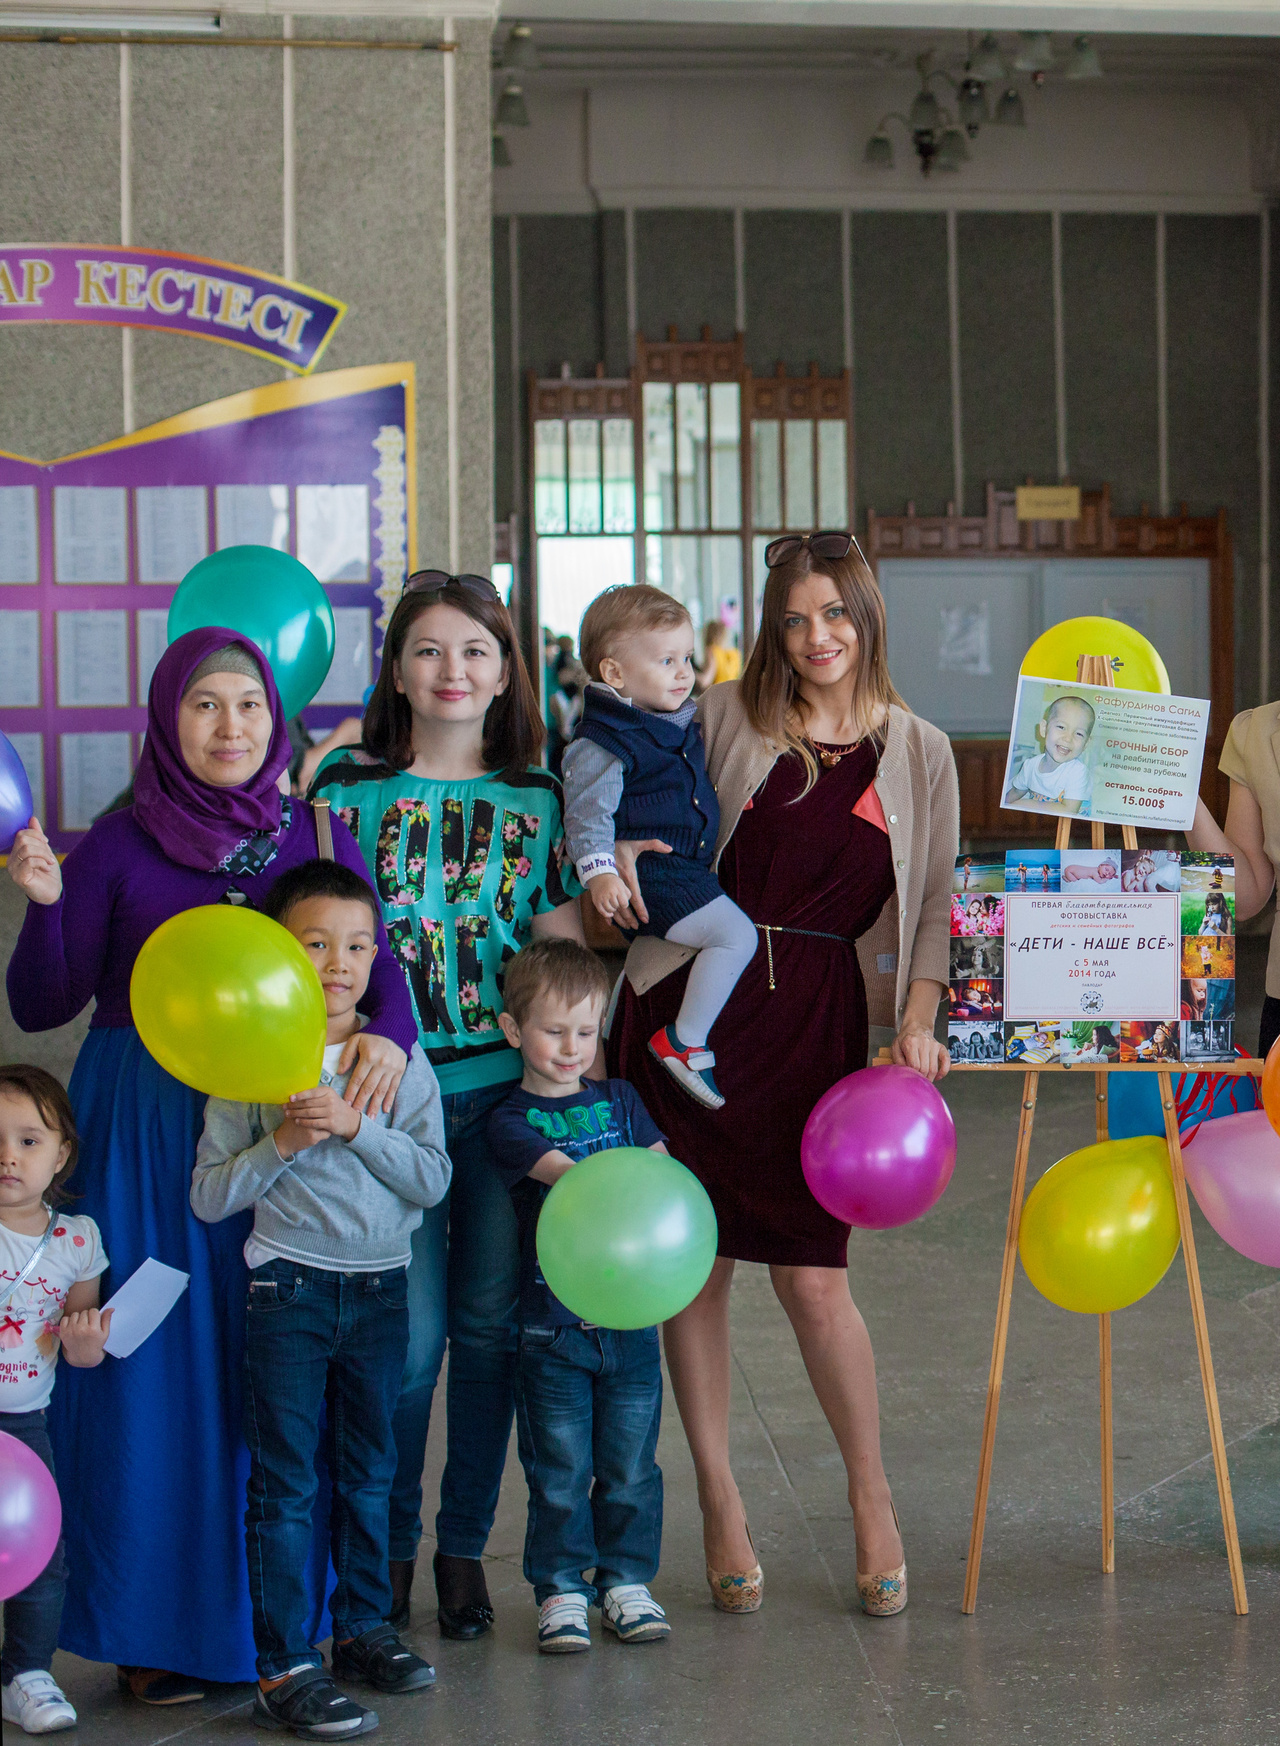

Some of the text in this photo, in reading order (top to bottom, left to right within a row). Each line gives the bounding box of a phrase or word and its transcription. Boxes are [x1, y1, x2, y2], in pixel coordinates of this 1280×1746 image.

[75, 260, 313, 351] КЕСТЕСІ
[1168, 704, 1201, 718] Сагид
[1105, 739, 1189, 757] СРОЧНЫЙ СБОР
[1123, 754, 1180, 768] реабилитацию
[1109, 762, 1142, 772] лечение
[1153, 768, 1187, 779] рубежом
[1104, 781, 1183, 797] осталось собрать
[1122, 794, 1165, 809] 15.000$
[338, 797, 541, 924] OVE
[1031, 900, 1153, 909] ПЕРВАЯ благотворительная
[1060, 912, 1128, 920] ФОТОВЫСТАВКА
[1010, 937, 1064, 952] «ДЕТИ
[1083, 937, 1130, 950] НАШЕ
[1136, 934, 1175, 950] ВСЁ»
[1083, 958, 1089, 967] 5
[1091, 959, 1109, 967] МАЯ
[1068, 969, 1117, 979] 2014 ГОДА
[526, 1100, 612, 1139] SURF
